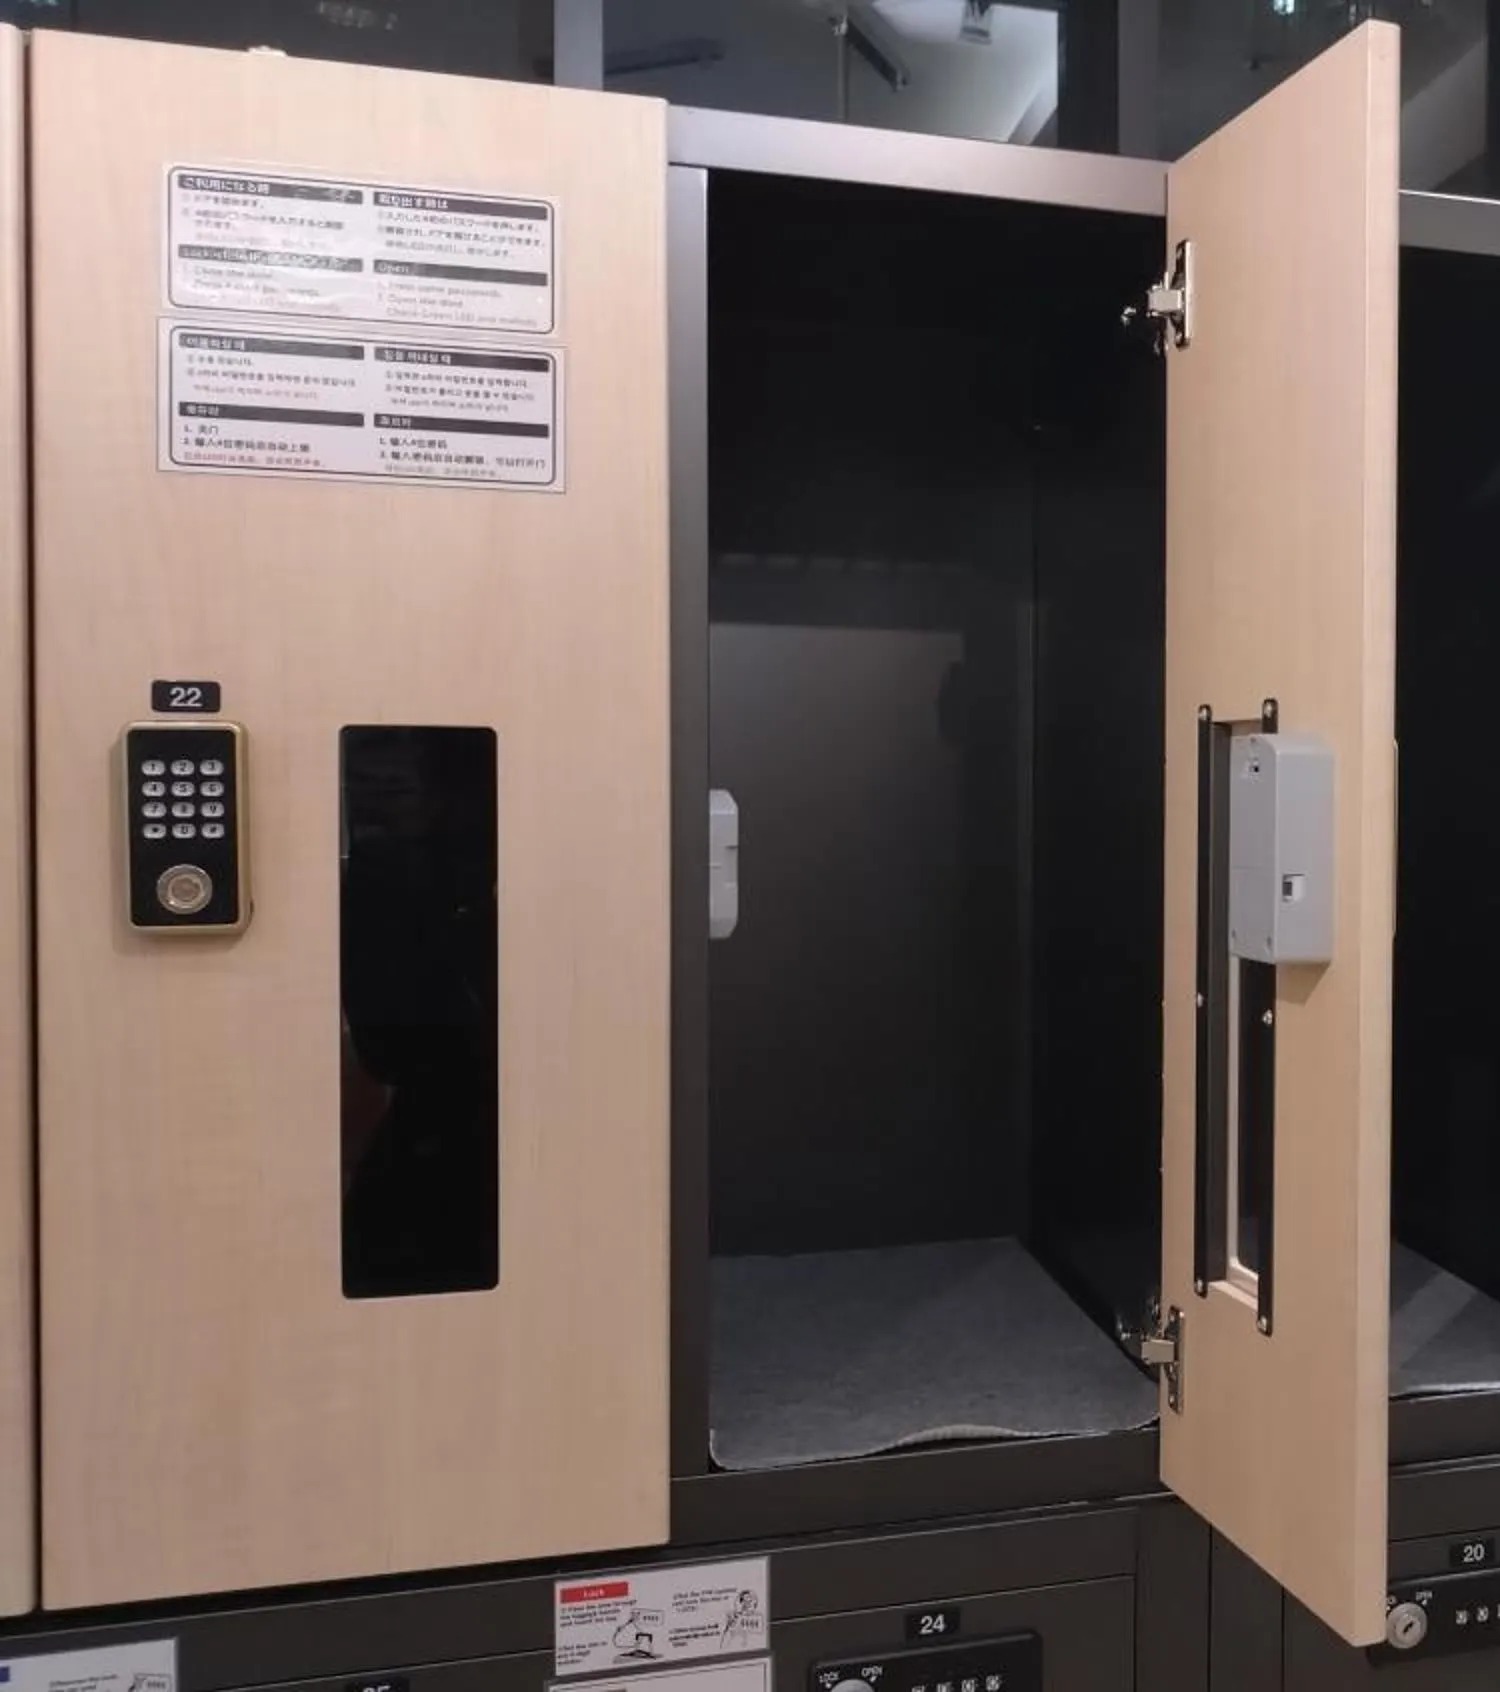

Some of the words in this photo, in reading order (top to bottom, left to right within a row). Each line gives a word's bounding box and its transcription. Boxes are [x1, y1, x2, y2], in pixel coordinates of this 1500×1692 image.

[169, 686, 203, 708] 22
[1463, 1543, 1485, 1563] 20
[919, 1614, 947, 1635] 24
[861, 1665, 883, 1678] OPEN
